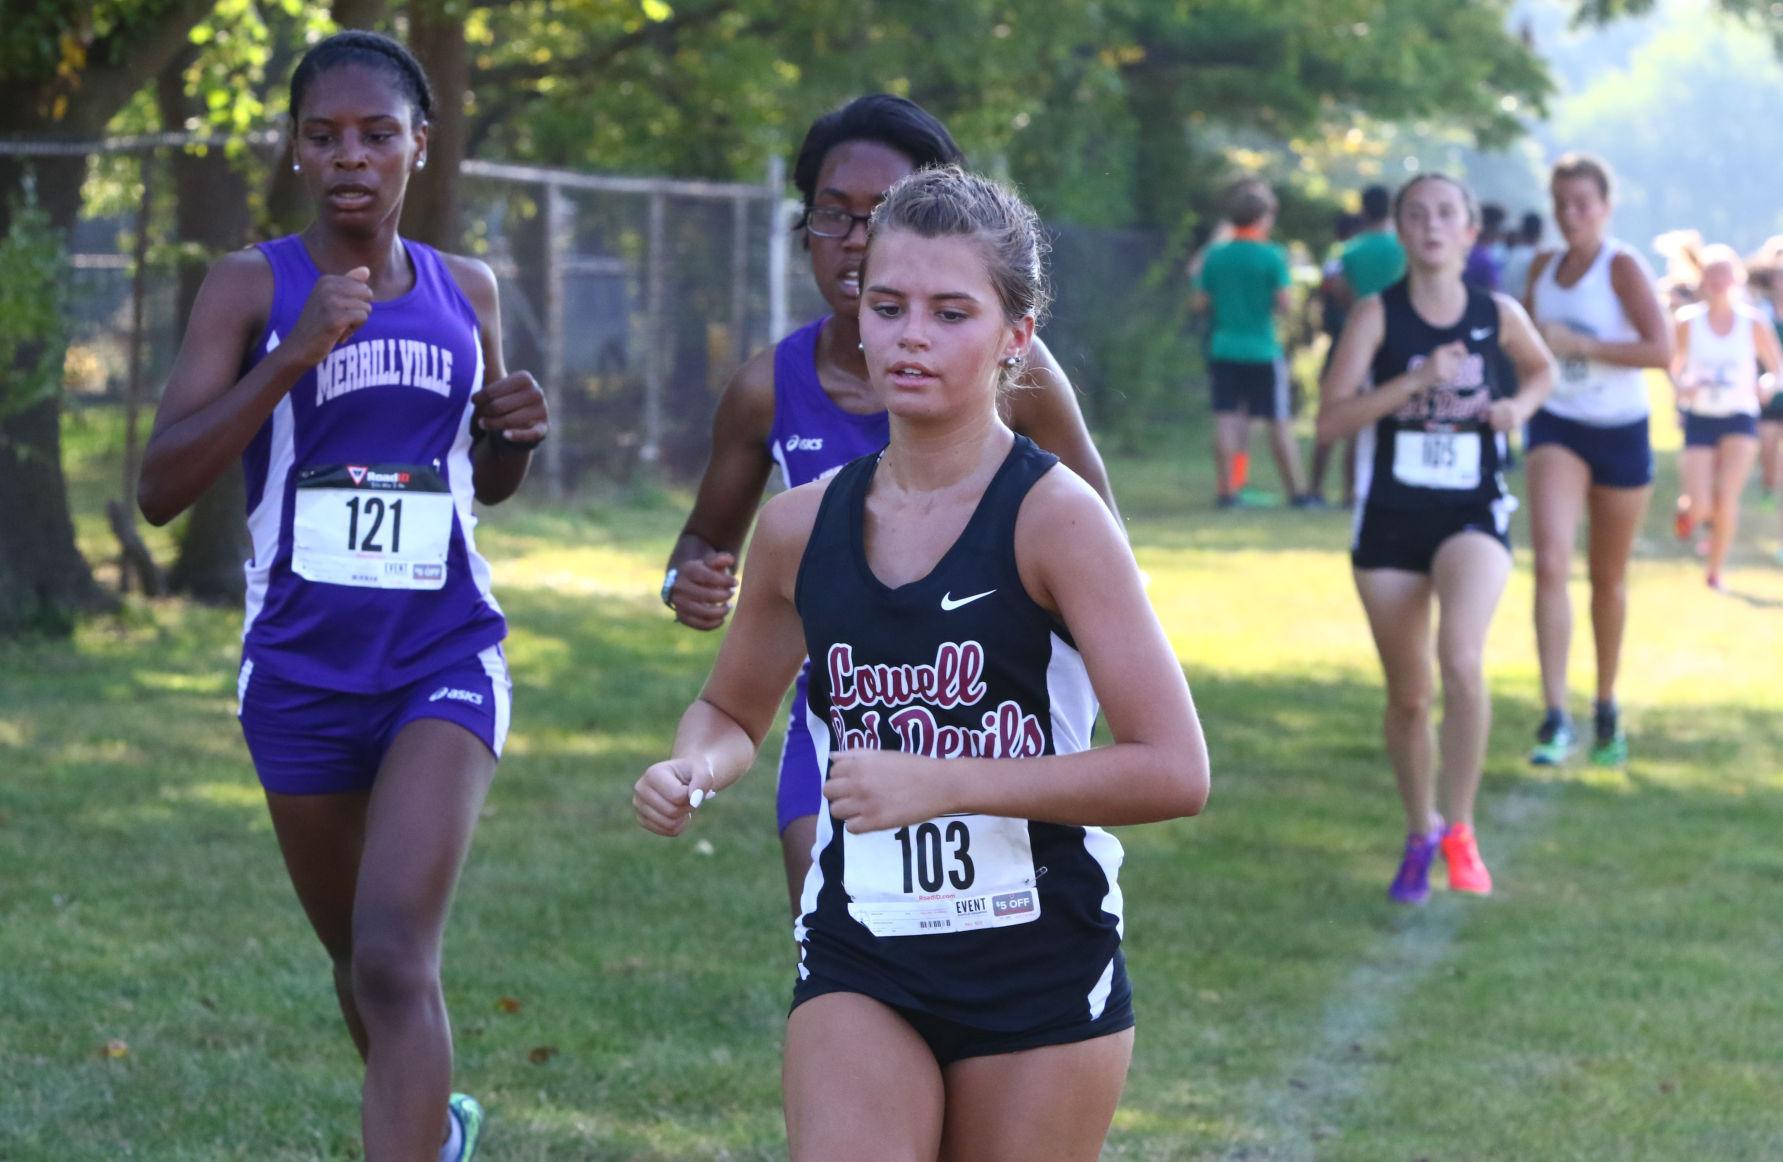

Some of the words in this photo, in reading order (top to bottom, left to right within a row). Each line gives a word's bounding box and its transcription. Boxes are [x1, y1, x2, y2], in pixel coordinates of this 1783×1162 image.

[316, 339, 453, 407] MERRILLVILLE
[346, 496, 402, 553] 121
[828, 640, 987, 710] Lowell
[894, 820, 975, 893] 103
[955, 897, 987, 914] EVENT
[995, 901, 1008, 911] $5
[1008, 897, 1030, 909] OFF
